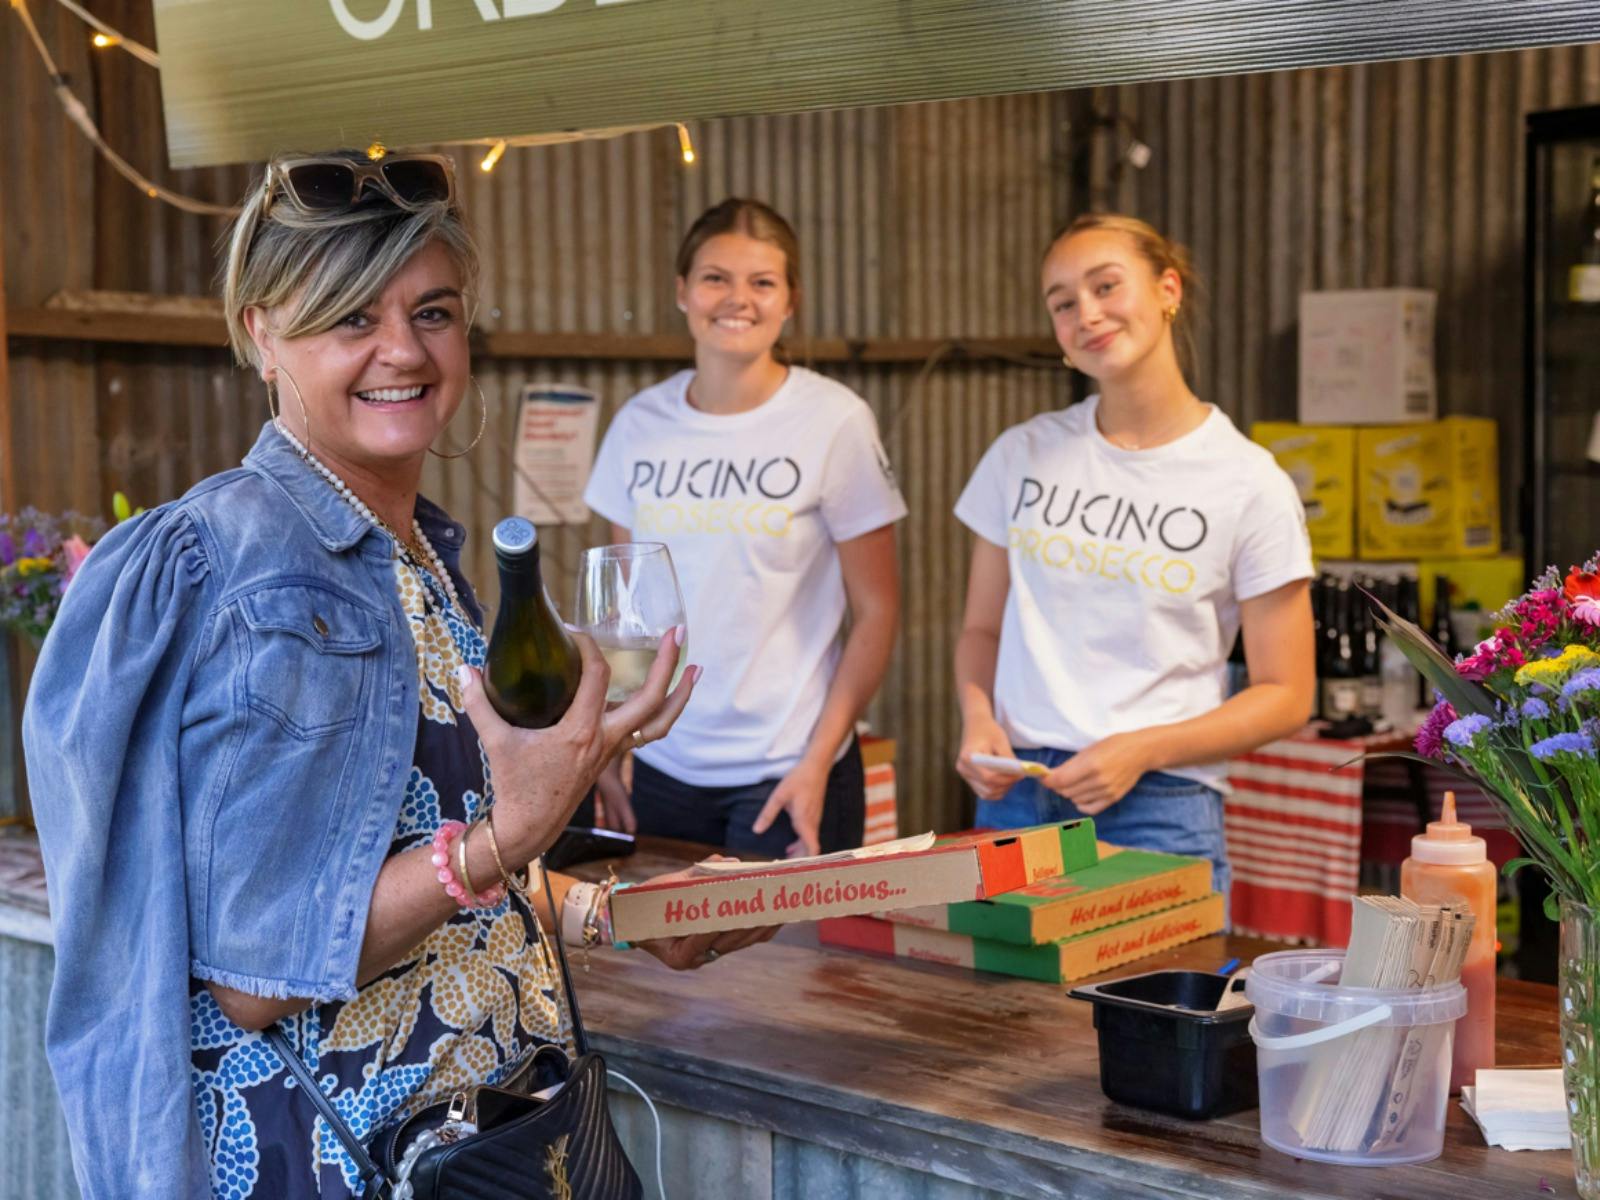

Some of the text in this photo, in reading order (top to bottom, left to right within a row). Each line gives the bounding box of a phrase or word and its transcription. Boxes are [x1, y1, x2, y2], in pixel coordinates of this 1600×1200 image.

[627, 456, 802, 500] PUCINO
[1012, 477, 1208, 552] PUCINO
[1008, 527, 1196, 594] PROSECCO
[664, 879, 907, 924] Hot and delicious...
